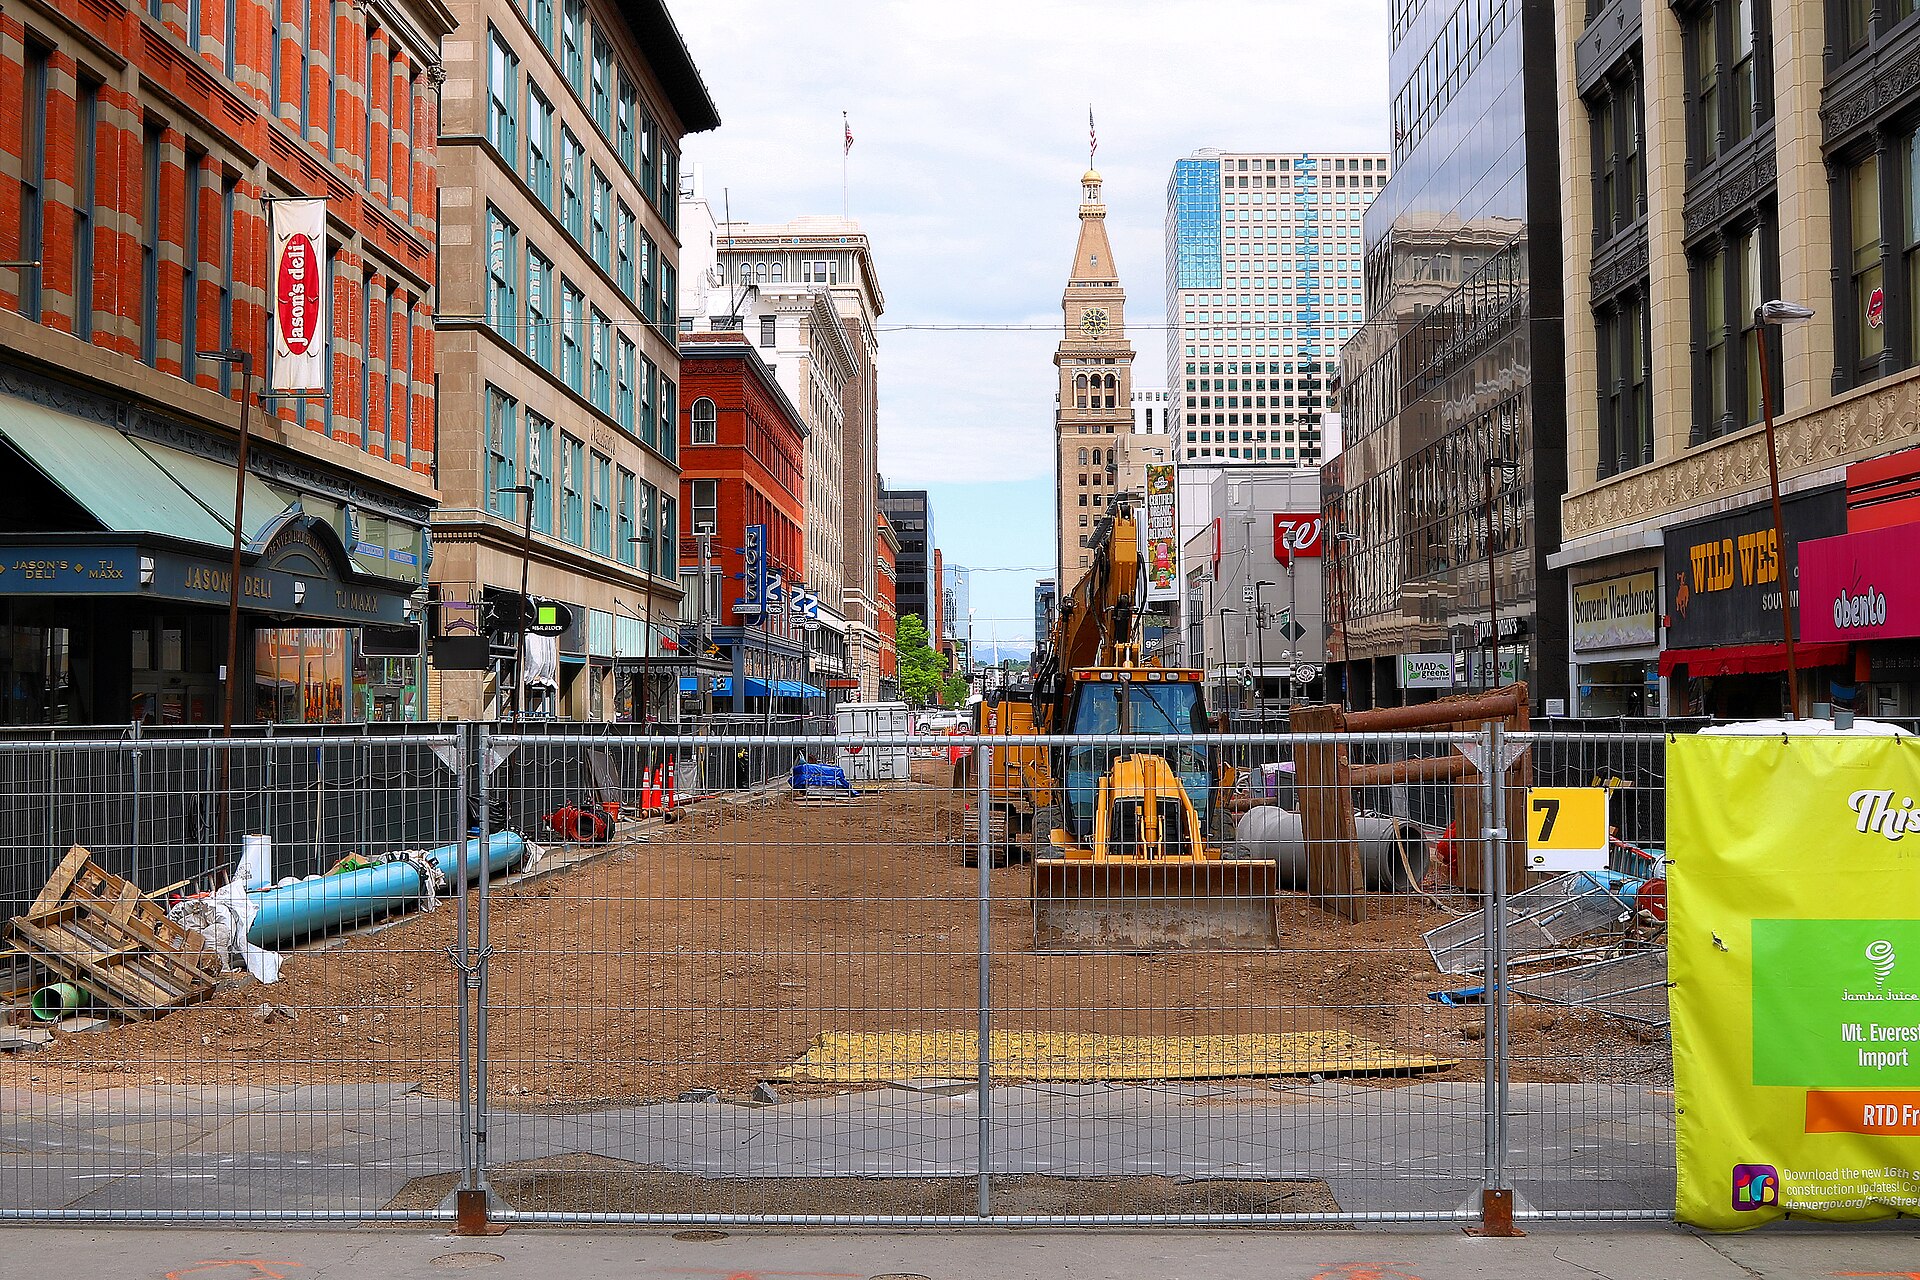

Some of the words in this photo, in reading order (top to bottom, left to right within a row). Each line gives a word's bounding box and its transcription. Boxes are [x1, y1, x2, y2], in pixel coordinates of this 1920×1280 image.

[288, 244, 304, 281] deli
[12, 560, 69, 570] JASON'S
[25, 570, 56, 579] DELI
[89, 570, 123, 579] MAXX
[98, 560, 113, 570] TJ
[1690, 538, 1734, 594] WILD
[185, 566, 233, 593] JASON'
[244, 575, 272, 599] DELI
[335, 590, 347, 609] TJ
[350, 592, 378, 613] MAXX
[1575, 588, 1607, 624] Souvenir
[1608, 581, 1654, 619] Warehouse
[1834, 586, 1886, 629] obento
[280, 628, 299, 646] MILE
[304, 628, 323, 648] HIGH
[326, 628, 341, 650] CITY
[1415, 663, 1436, 671] MAD
[1422, 669, 1449, 678] greens
[1533, 799, 1560, 841] 7
[1847, 789, 1920, 841] This
[1841, 989, 1884, 1000] jamba
[1885, 989, 1919, 1000] juice
[1841, 1023, 1867, 1042] Mt.
[1858, 1048, 1909, 1070] Import
[1863, 1104, 1898, 1126] RTD
[1902, 1104, 1920, 1126] Fr
[1784, 1168, 1839, 1180] Download
[1841, 1167, 1860, 1179] the
[1862, 1168, 1881, 1178] new
[1884, 1167, 1909, 1178] 16th
[1786, 1183, 1854, 1195] construction
[1857, 1181, 1900, 1195] updates!
